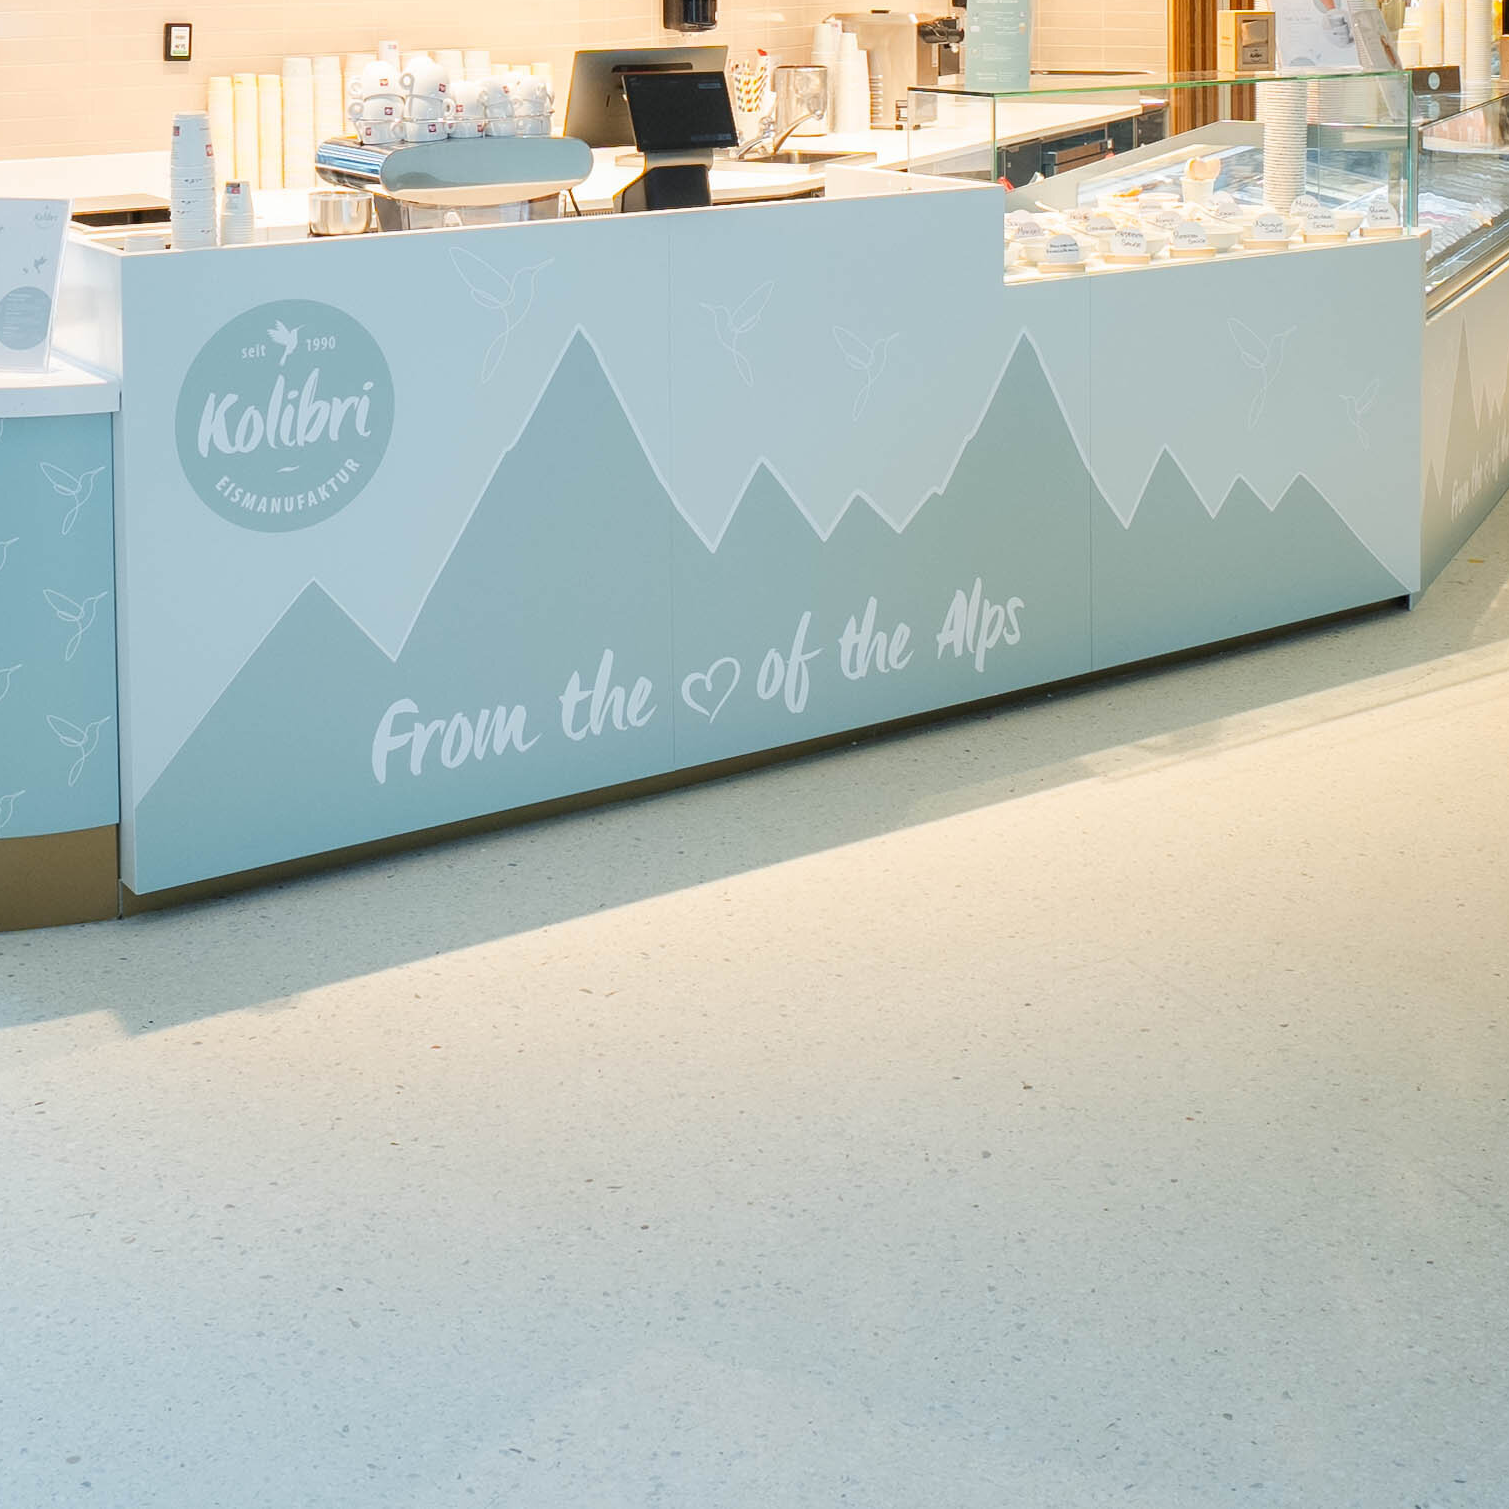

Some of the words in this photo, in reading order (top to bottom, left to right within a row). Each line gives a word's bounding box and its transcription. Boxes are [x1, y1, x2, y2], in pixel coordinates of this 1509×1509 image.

[242, 344, 267, 359] seit
[306, 336, 336, 352] 1990
[198, 368, 374, 458] Kolibri
[215, 458, 361, 524] EISMANUFAKTUR
[371, 698, 542, 784] From
[558, 648, 658, 741] the
[757, 610, 825, 713] of
[838, 596, 915, 680] the
[936, 577, 1025, 673] Alps
